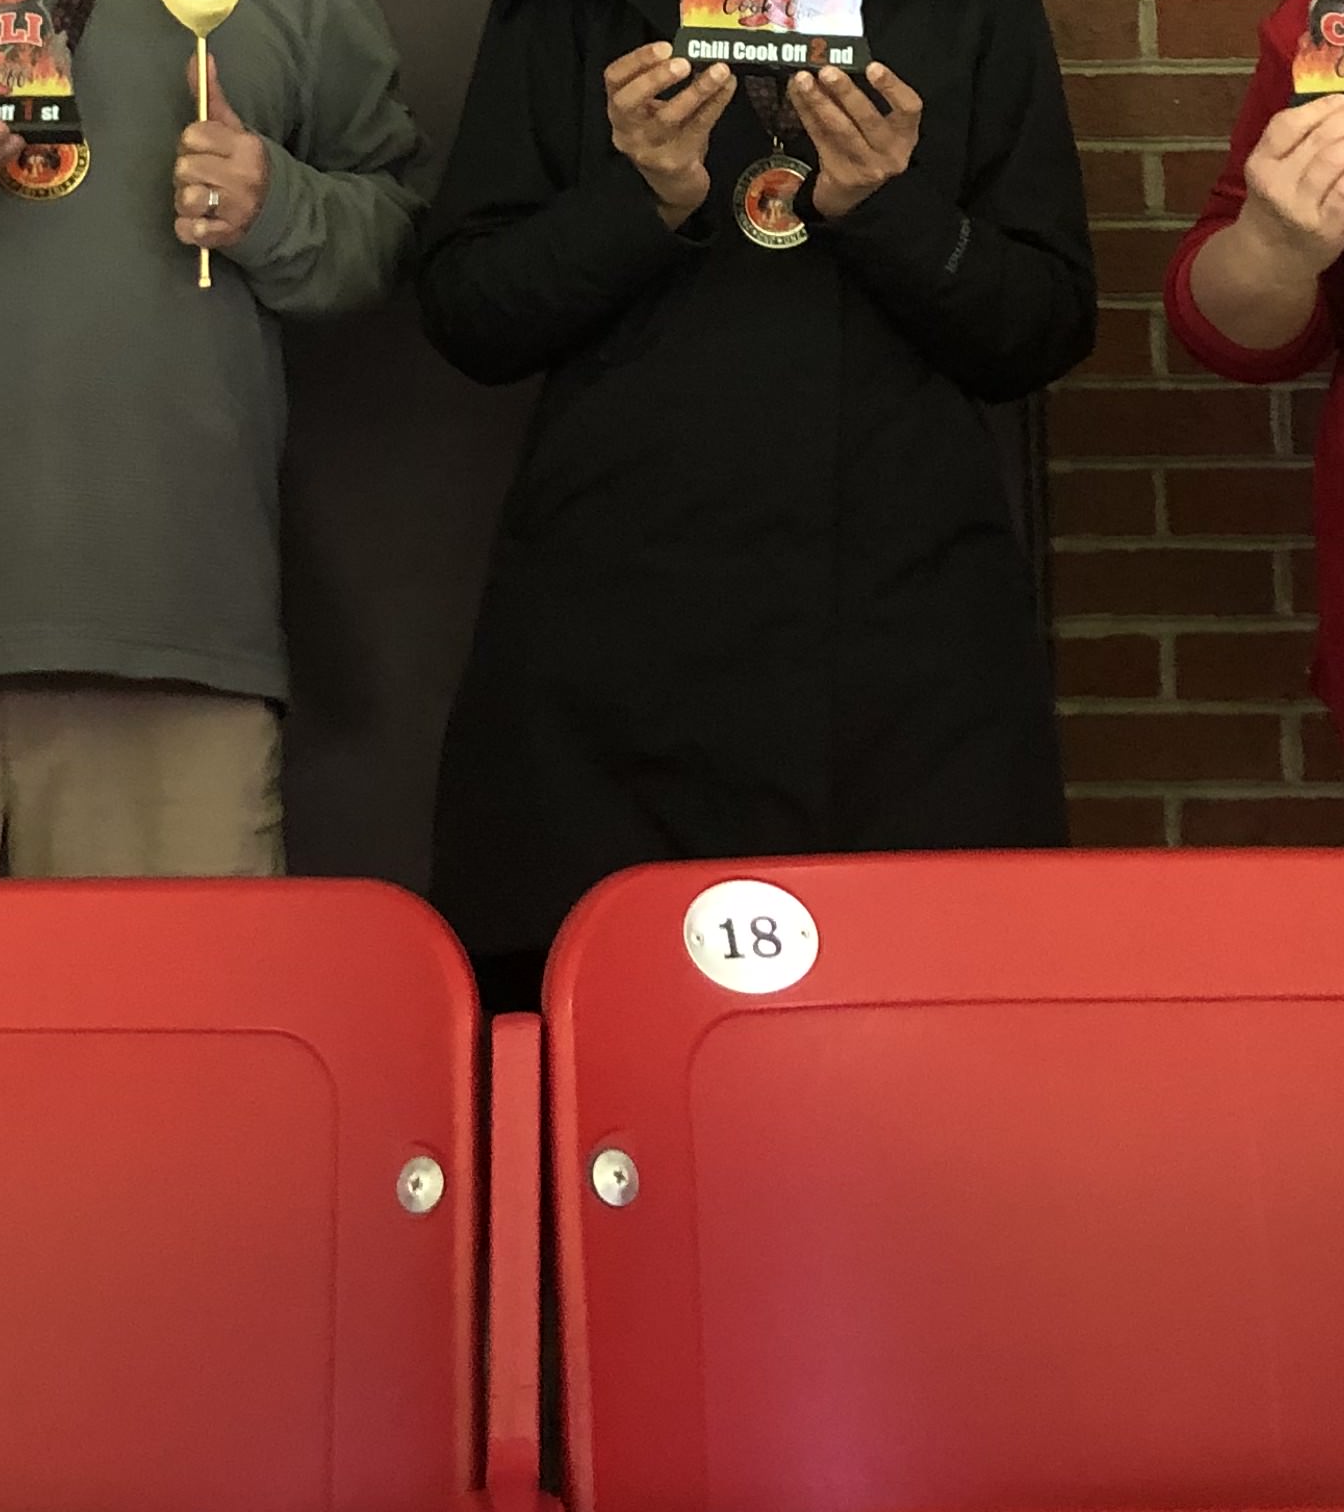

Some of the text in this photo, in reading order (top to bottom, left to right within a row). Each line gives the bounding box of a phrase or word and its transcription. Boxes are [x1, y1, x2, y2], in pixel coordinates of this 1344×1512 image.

[688, 40, 729, 59] Chili
[733, 42, 778, 62] Cook
[782, 44, 807, 63] Off
[719, 916, 782, 959] 18
